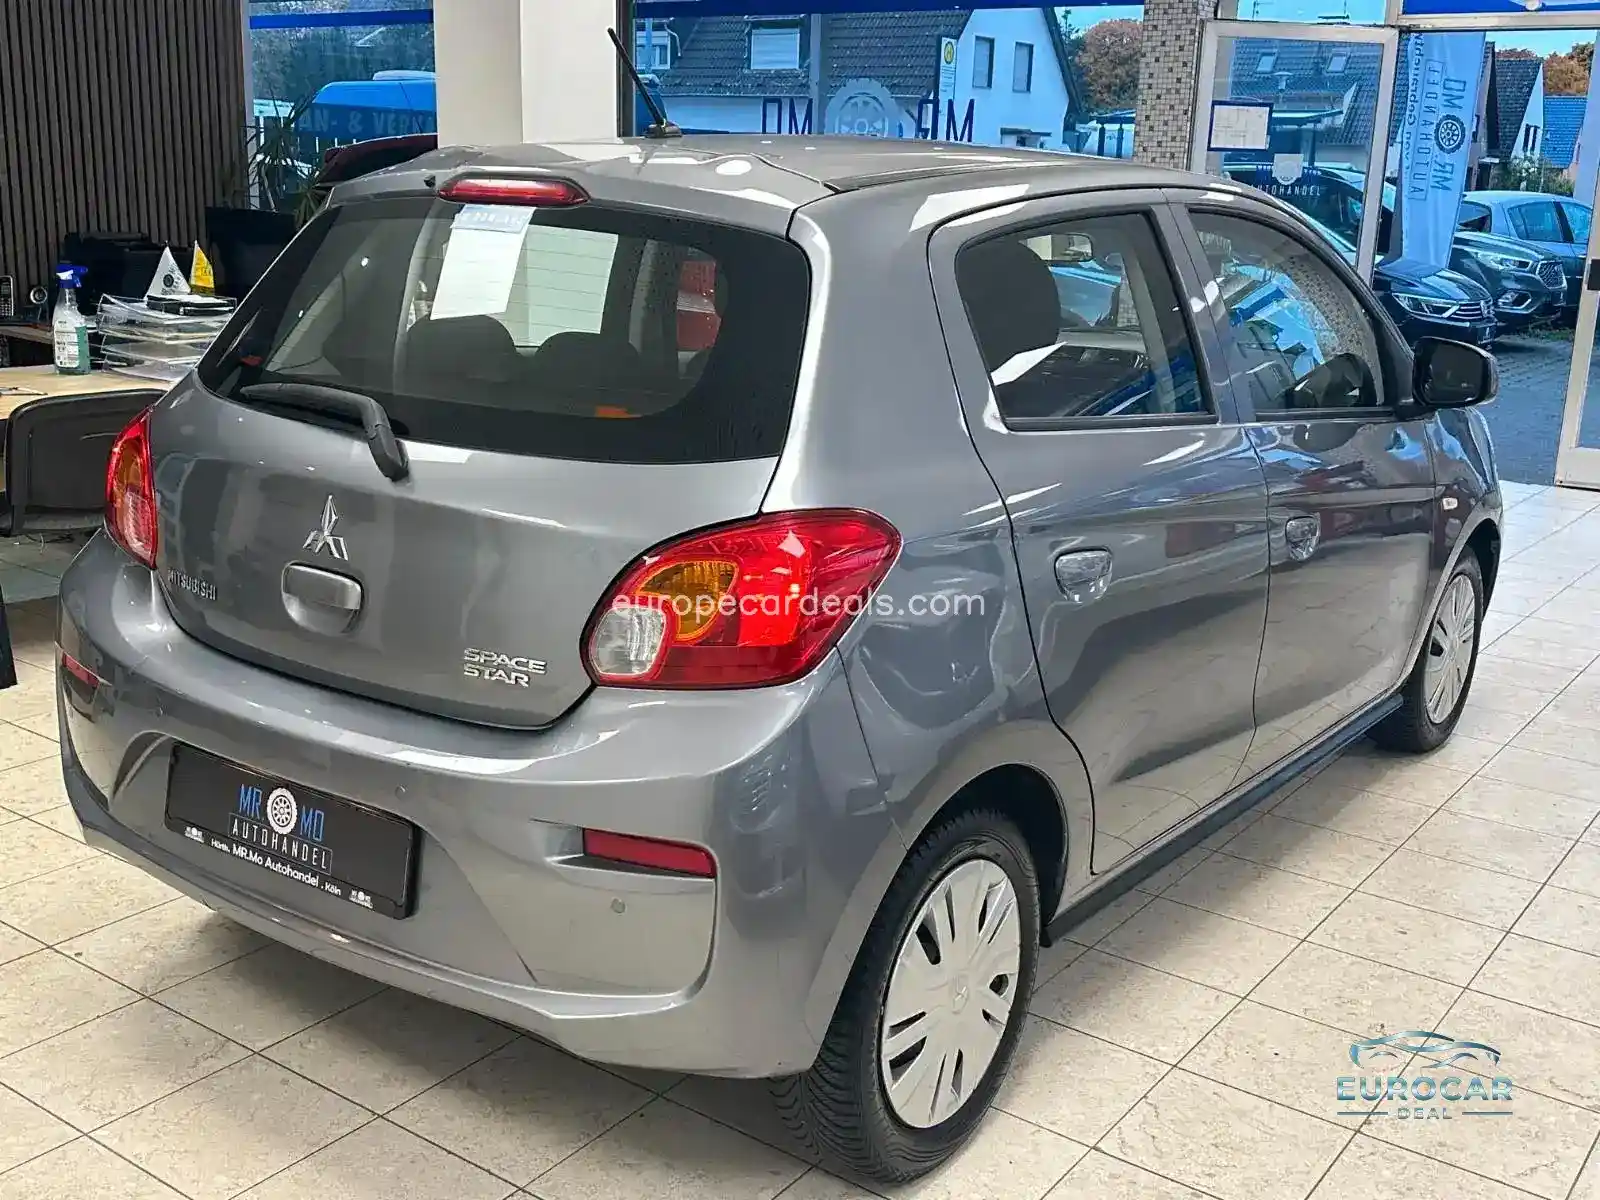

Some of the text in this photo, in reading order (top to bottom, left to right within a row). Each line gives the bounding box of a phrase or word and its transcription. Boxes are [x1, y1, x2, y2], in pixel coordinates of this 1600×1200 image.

[167, 568, 218, 601] MITSUBISHI
[463, 647, 547, 675] SPACE
[463, 663, 529, 688] STAR
[300, 805, 325, 842] MO
[232, 818, 327, 869] AUTOHANDEL
[264, 856, 319, 888] Autohandel
